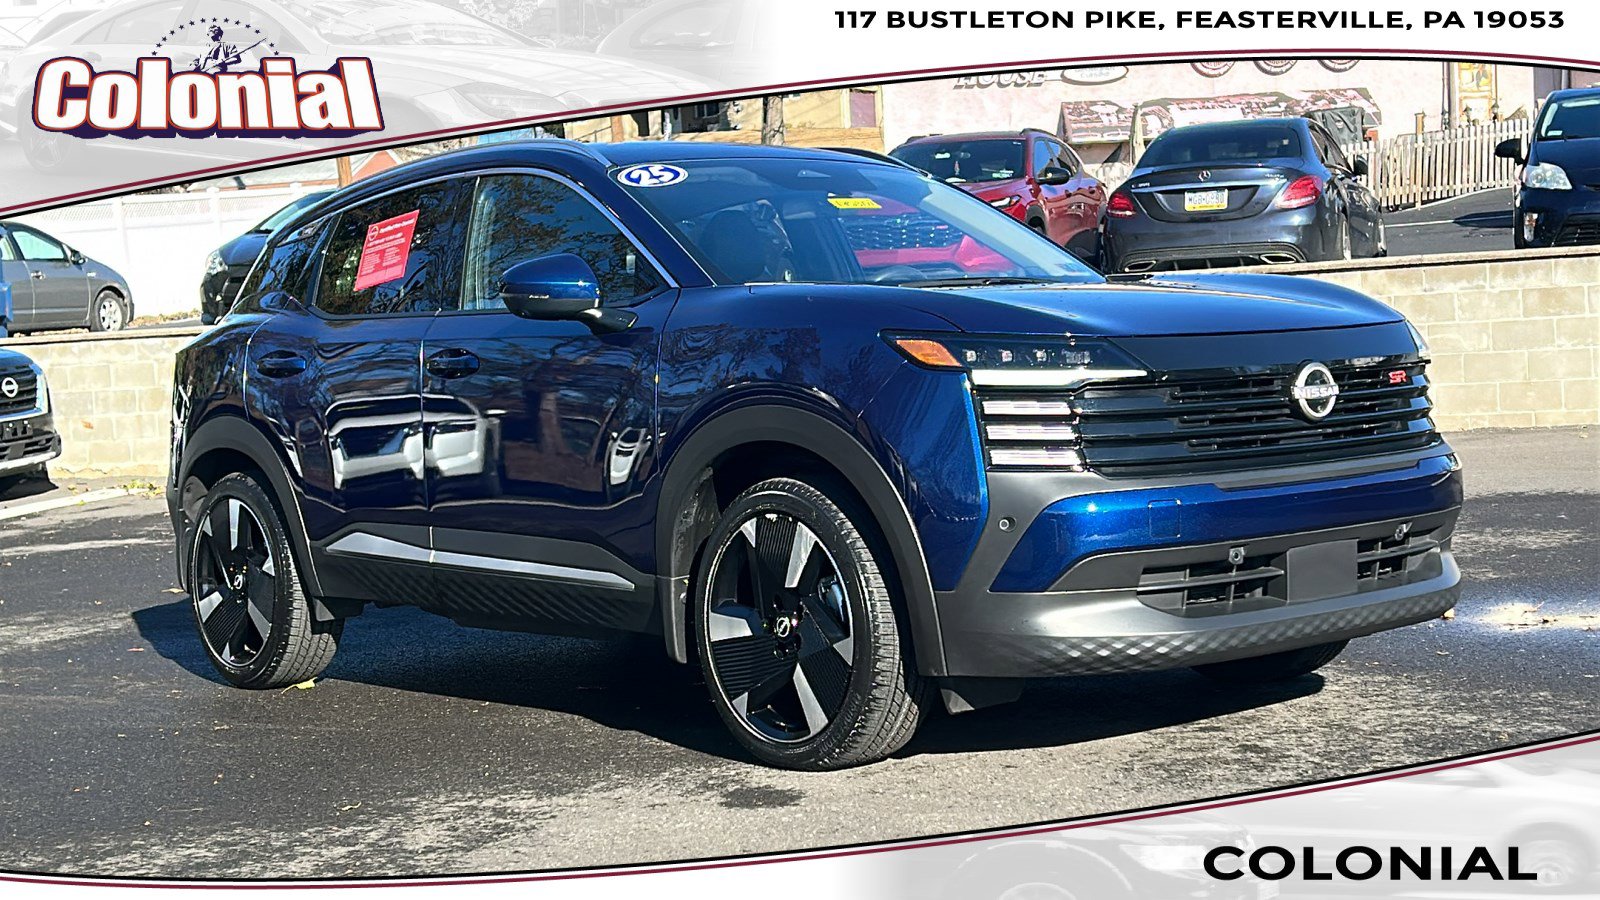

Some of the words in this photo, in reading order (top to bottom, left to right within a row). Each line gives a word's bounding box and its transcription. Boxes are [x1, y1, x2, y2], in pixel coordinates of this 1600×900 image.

[630, 165, 675, 185] 25
[1388, 370, 1407, 384] SR
[1294, 385, 1339, 398] NISSAN
